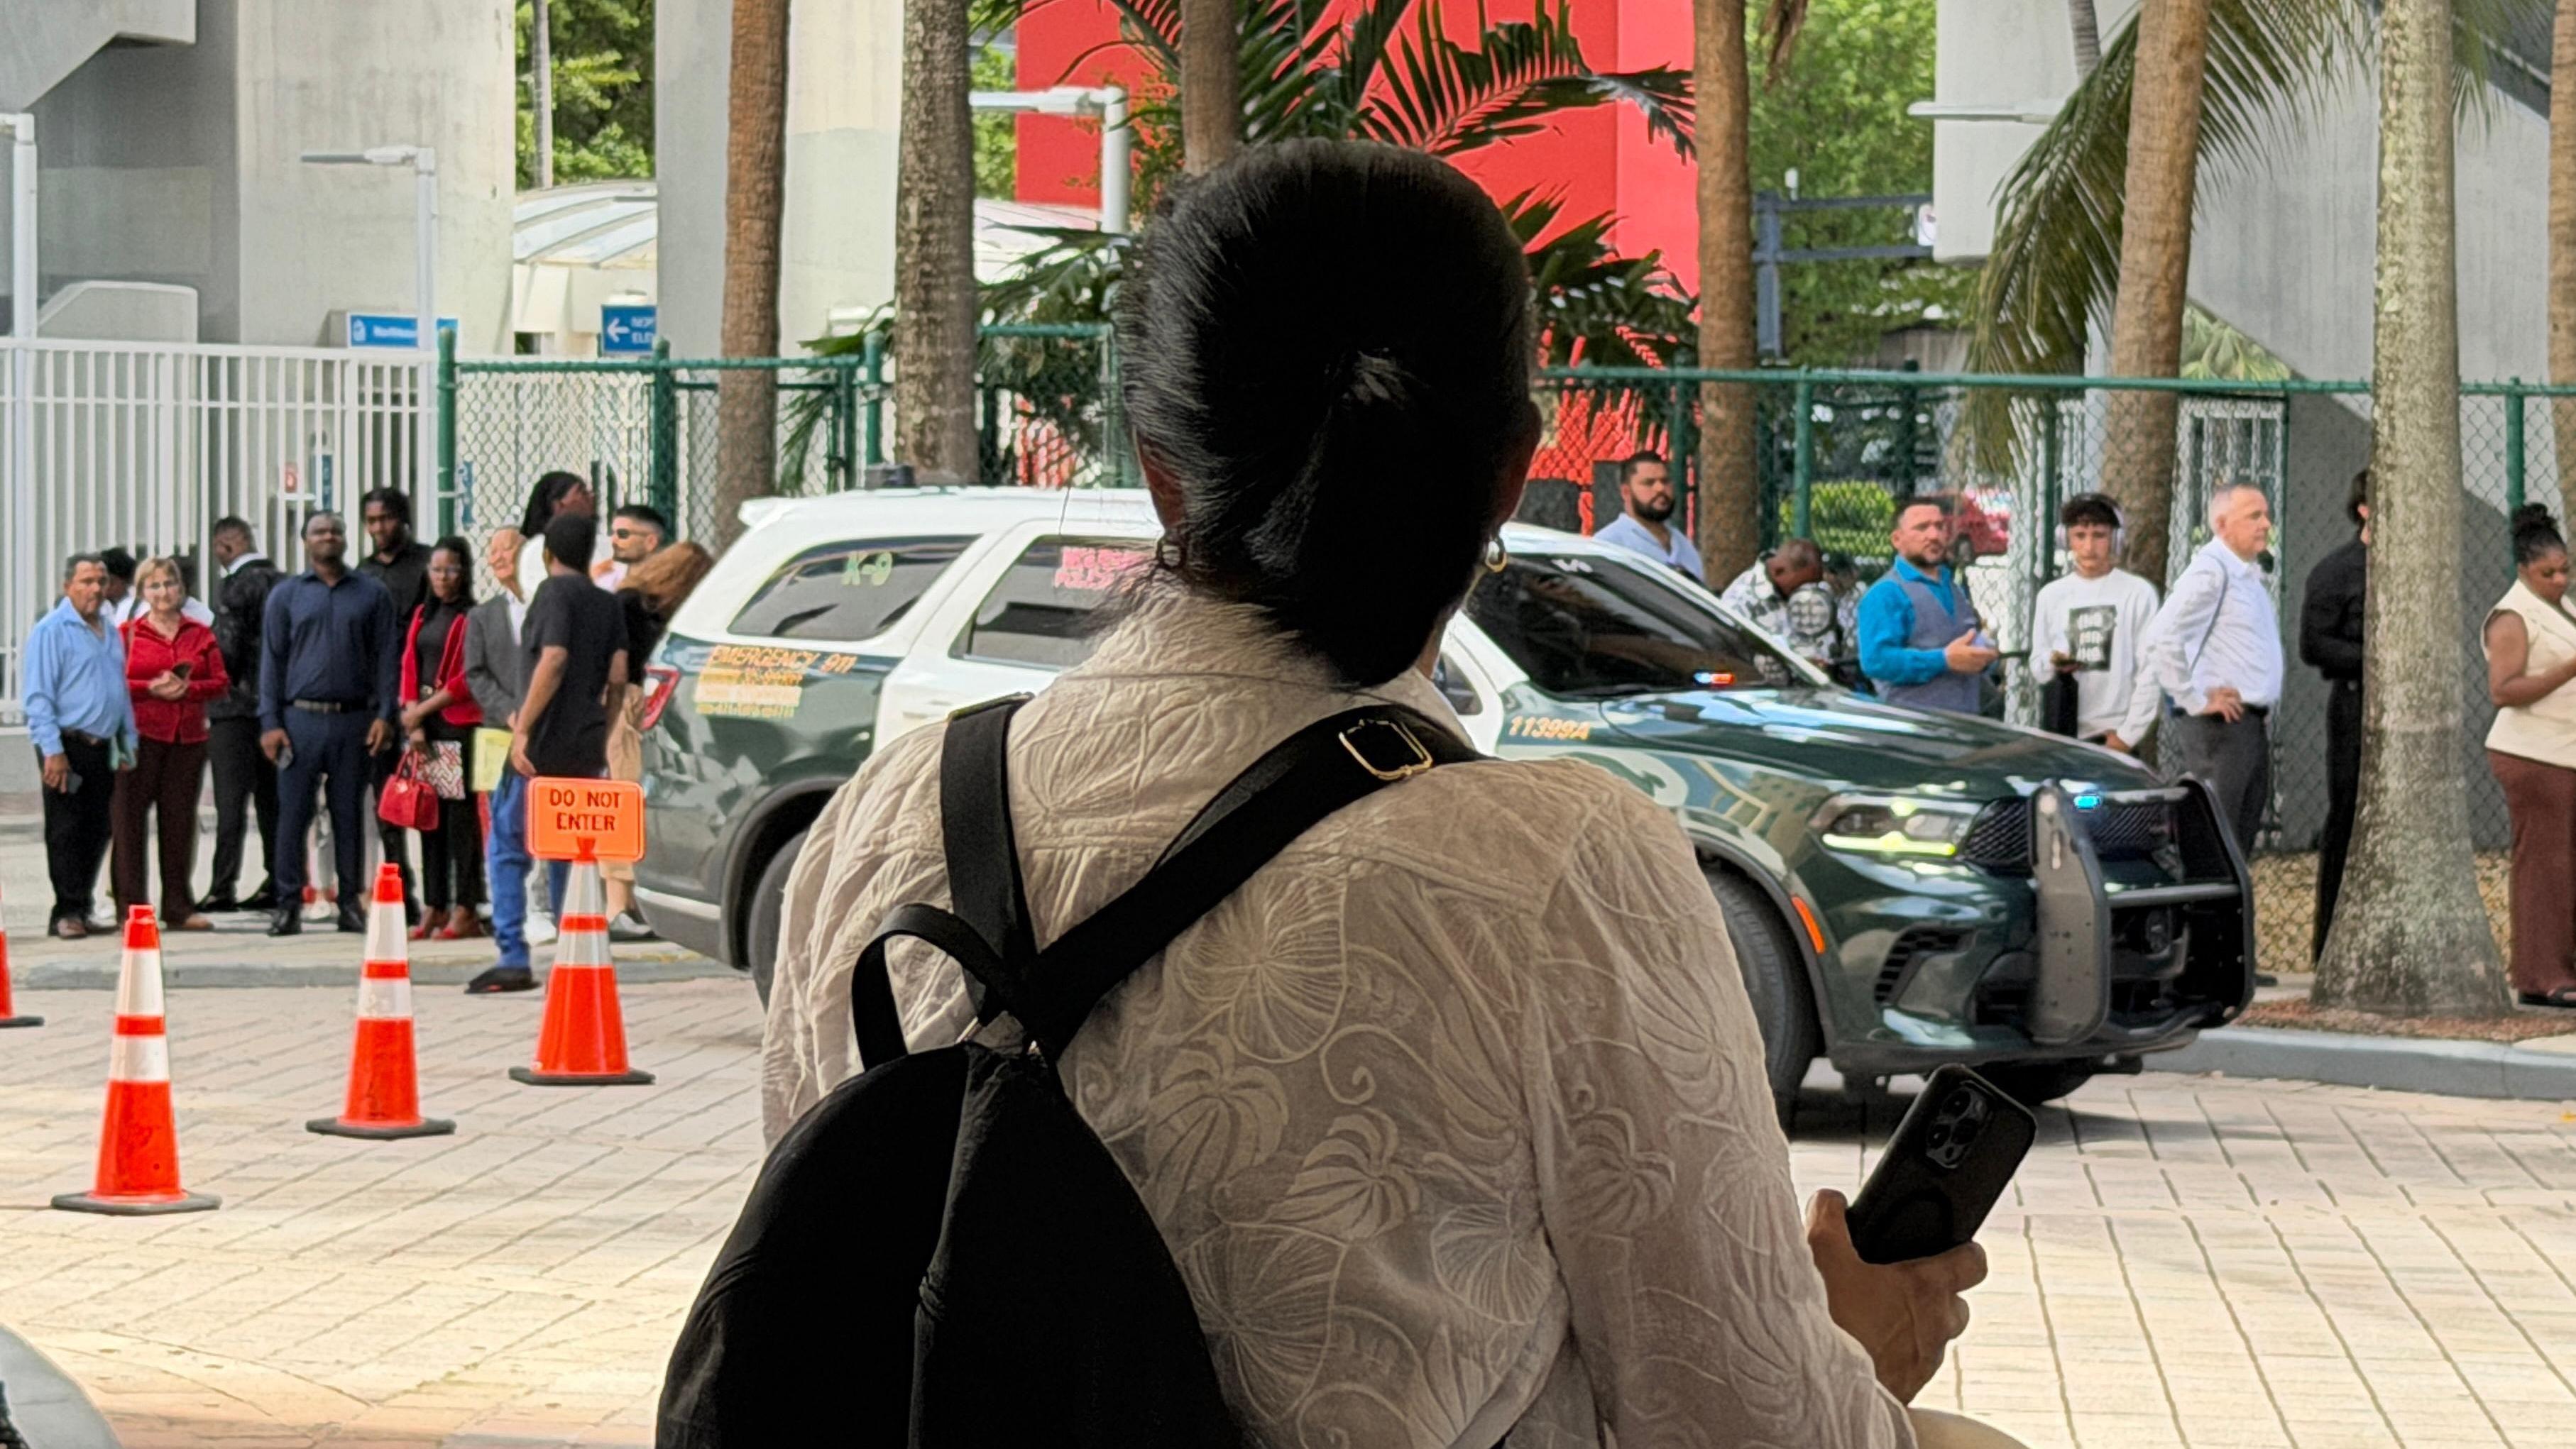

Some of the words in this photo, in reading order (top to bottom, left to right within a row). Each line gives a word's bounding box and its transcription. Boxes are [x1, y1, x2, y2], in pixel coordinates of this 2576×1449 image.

[840, 552, 892, 586] K-9
[710, 645, 820, 668] EMERGENCY
[821, 654, 857, 673] 911
[549, 789, 575, 806] DO
[588, 791, 620, 808] NOT
[557, 812, 615, 831] ENTER
